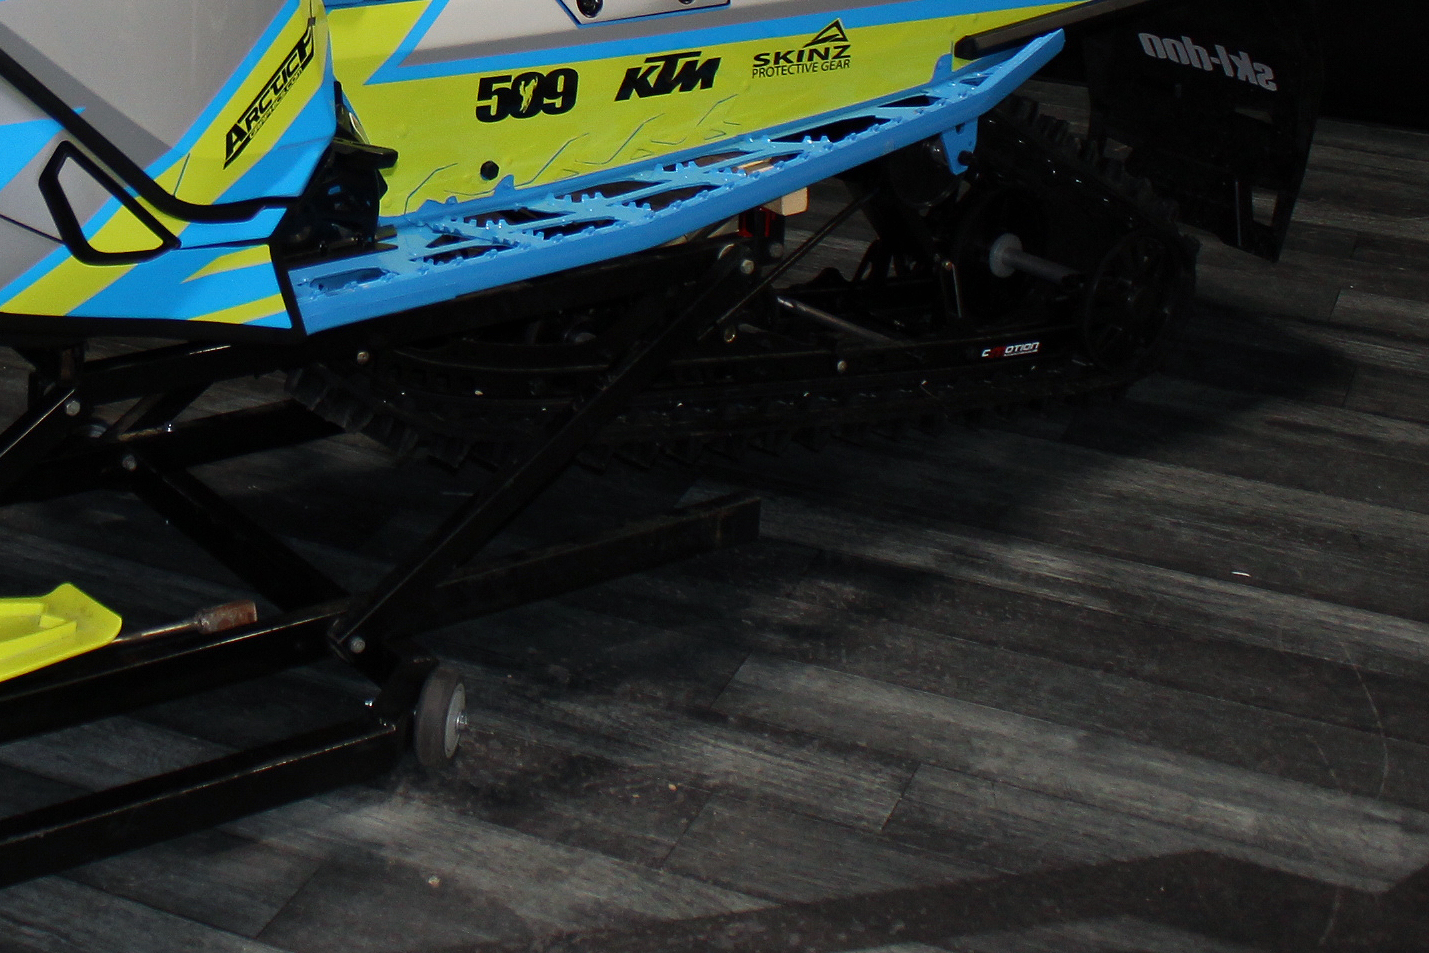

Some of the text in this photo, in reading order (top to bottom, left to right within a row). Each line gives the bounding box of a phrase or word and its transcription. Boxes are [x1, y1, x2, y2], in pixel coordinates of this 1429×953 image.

[752, 59, 850, 78] PROTECTIVE GEAR
[753, 45, 851, 68] SKINZ
[614, 51, 721, 101] KTM
[475, 68, 578, 123] 509
